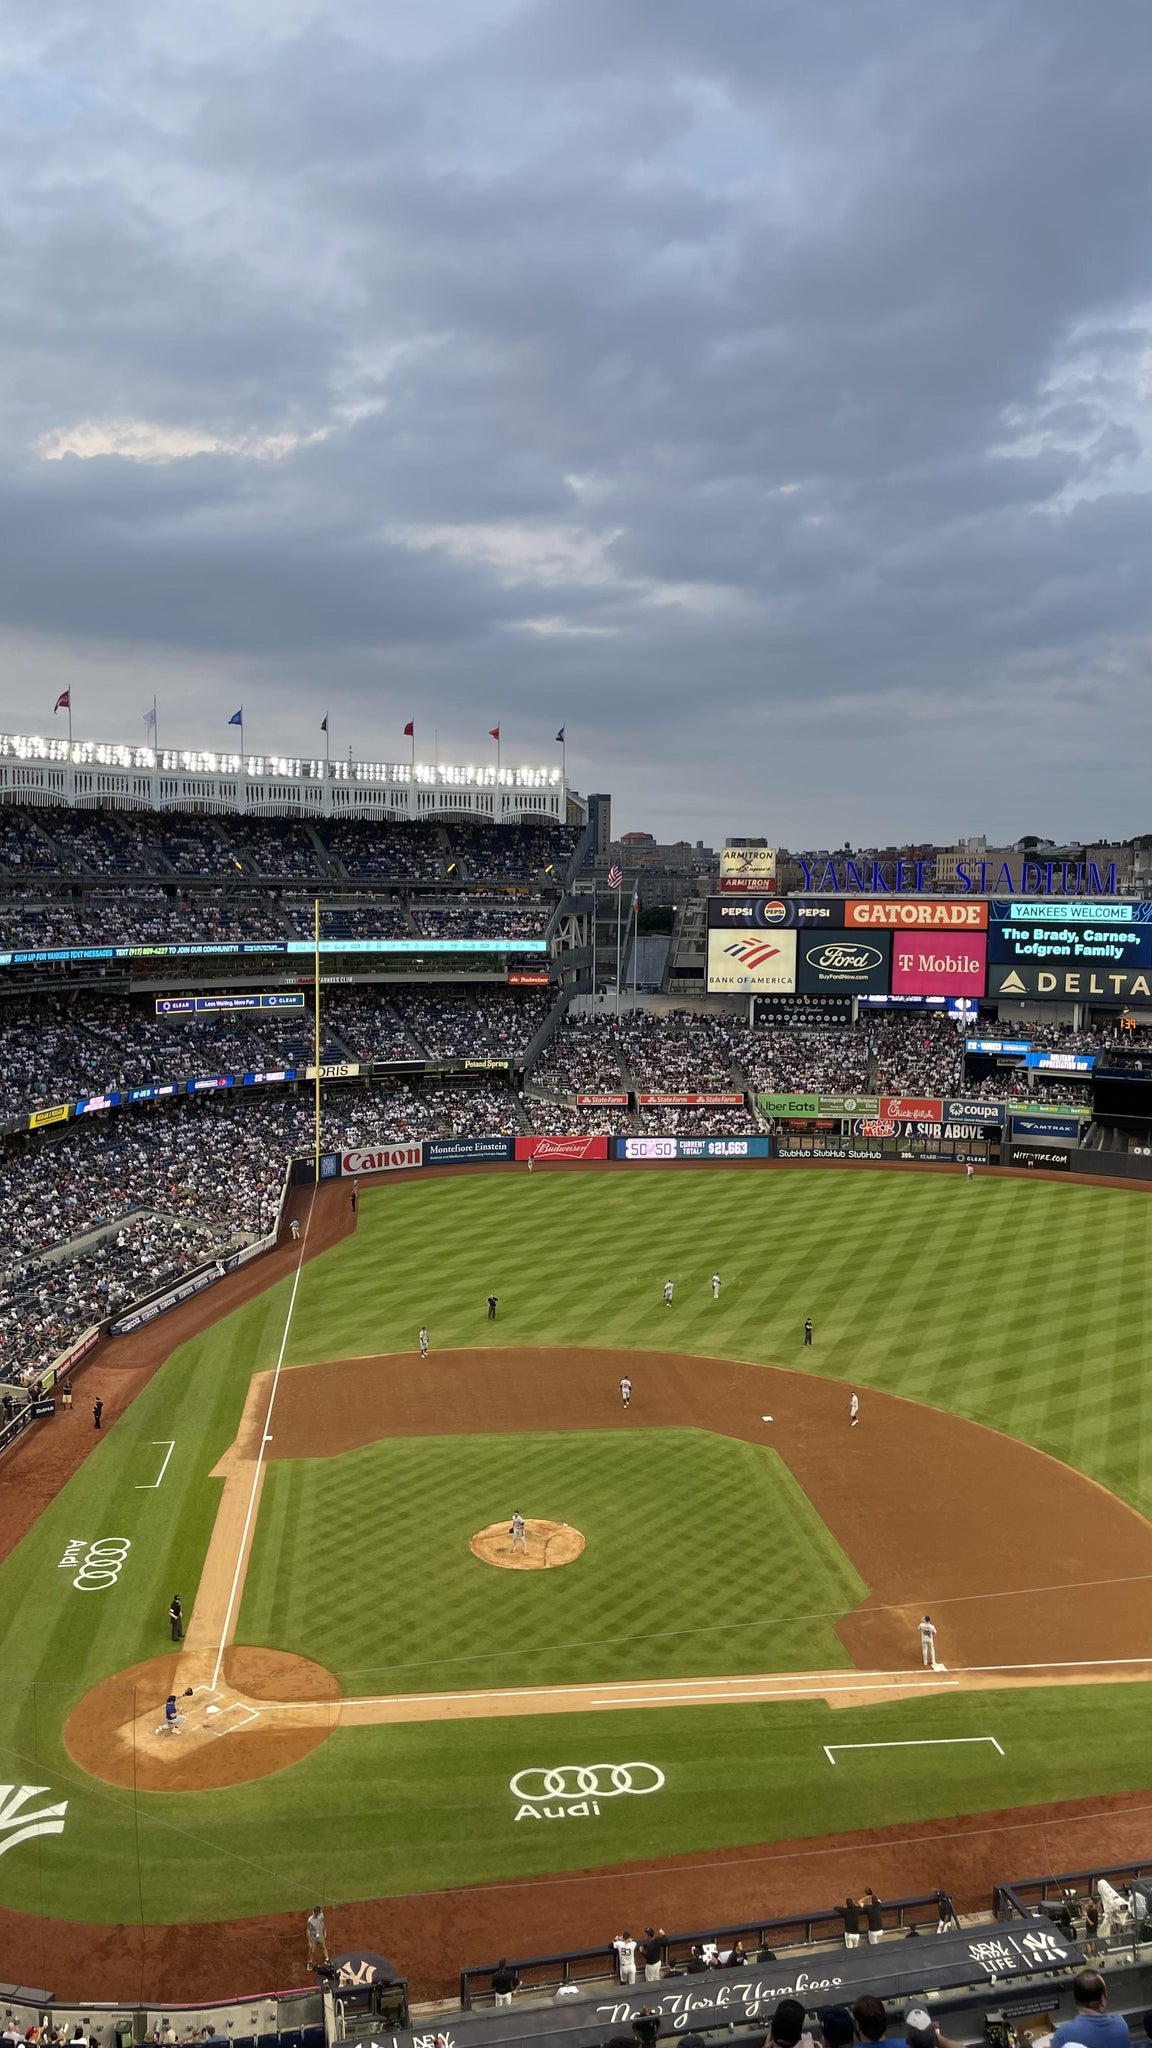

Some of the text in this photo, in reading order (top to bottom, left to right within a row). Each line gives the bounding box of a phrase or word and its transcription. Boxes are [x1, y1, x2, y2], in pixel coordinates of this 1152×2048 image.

[723, 851, 773, 859] ARMITRON
[799, 860, 1119, 895] YANKEE STADIUM
[721, 907, 753, 916] PEPSI
[798, 908, 830, 917] PEPSI
[853, 905, 981, 924] GATORADE
[1016, 907, 1127, 918] YANKEES WELCOME
[1001, 928, 1141, 945] The Brady, Carnes,
[28, 952, 37, 961] UP
[48, 951, 70, 960] YANKEES
[116, 948, 129, 956] TEXT
[177, 946, 190, 954] JOIN
[191, 946, 203, 954] OUR
[819, 946, 870, 968] Ford
[1015, 942, 1124, 959] Lofgren Family
[899, 954, 980, 973] T Mobile
[1037, 972, 1151, 996] DELTA
[465, 1060, 509, 1069] Poland Spring
[788, 1101, 816, 1111] Eats
[964, 1104, 999, 1118] coupa
[860, 1119, 895, 1128] Jersey
[905, 1122, 985, 1139] A SUB ABOVE
[430, 1142, 507, 1154] Montefiore Einstein
[539, 1142, 586, 1154] Budweiser
[631, 1143, 672, 1156] 50 50
[708, 1141, 748, 1156] $21,663
[779, 1149, 881, 1159] StubHub StubHub StubHub
[343, 1148, 421, 1172] Canon
[57, 1540, 88, 1568] Audi
[514, 1800, 600, 1821] Audi
[968, 1940, 1001, 1955] NEW
[979, 1957, 1017, 1973] LIFE
[663, 1986, 730, 2029] York
[732, 1973, 843, 2017] Yankees
